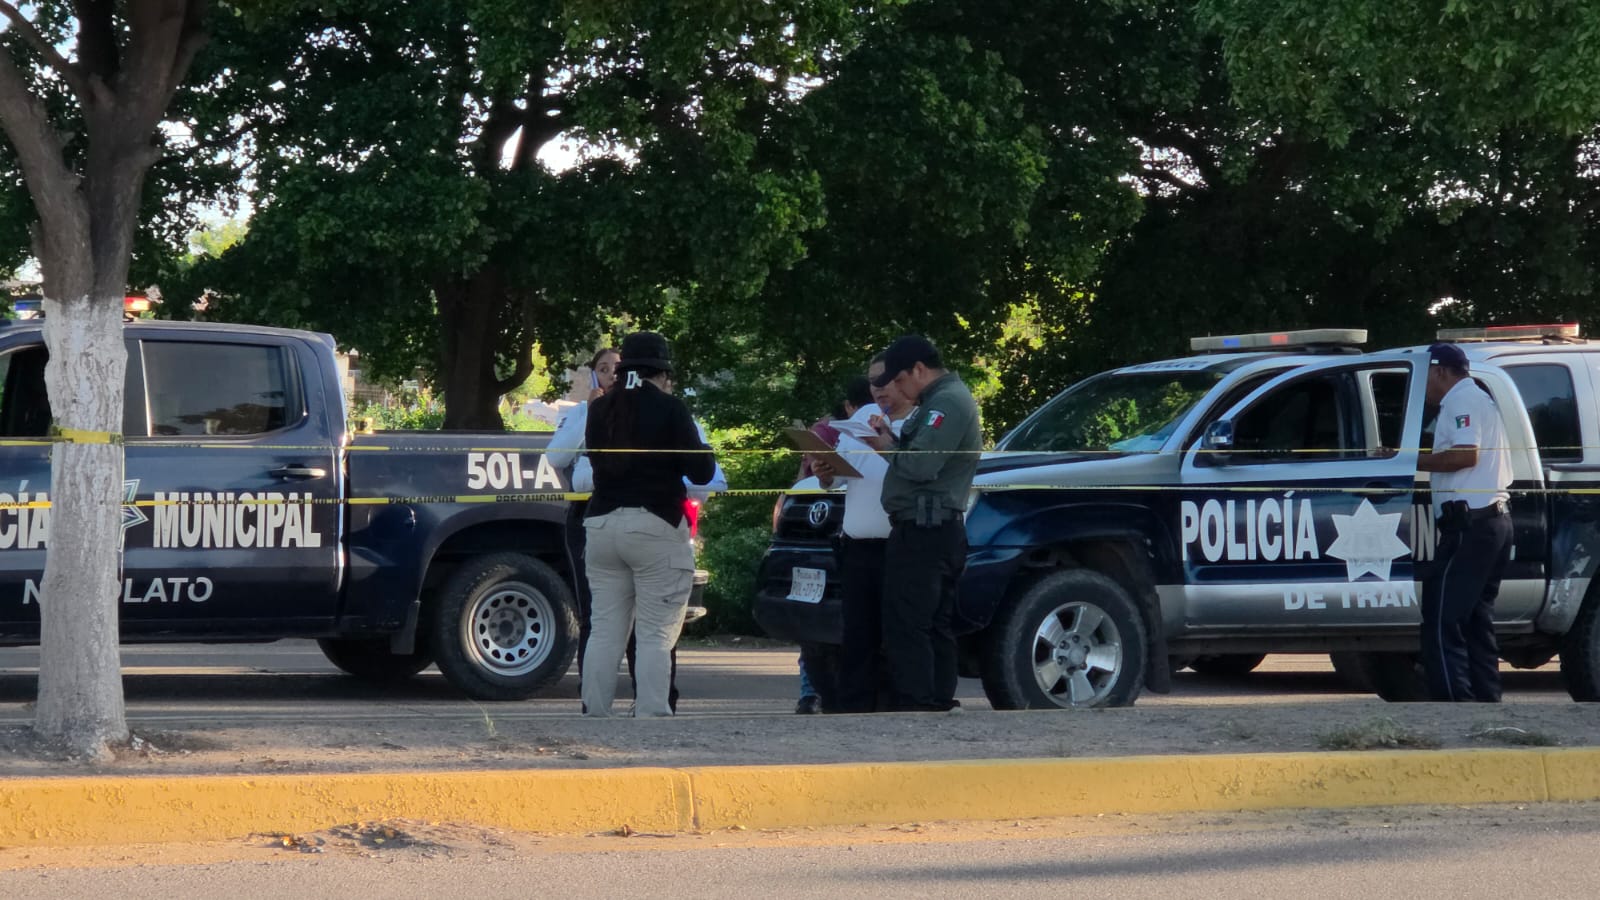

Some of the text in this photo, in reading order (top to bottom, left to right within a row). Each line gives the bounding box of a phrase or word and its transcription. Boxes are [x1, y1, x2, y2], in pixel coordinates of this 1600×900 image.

[467, 453, 562, 489] 501-A
[153, 491, 321, 548] MUNICIPAL
[1181, 490, 1320, 562] POLICÍA
[23, 577, 213, 604] NLATO
[1283, 587, 1327, 610] DE
